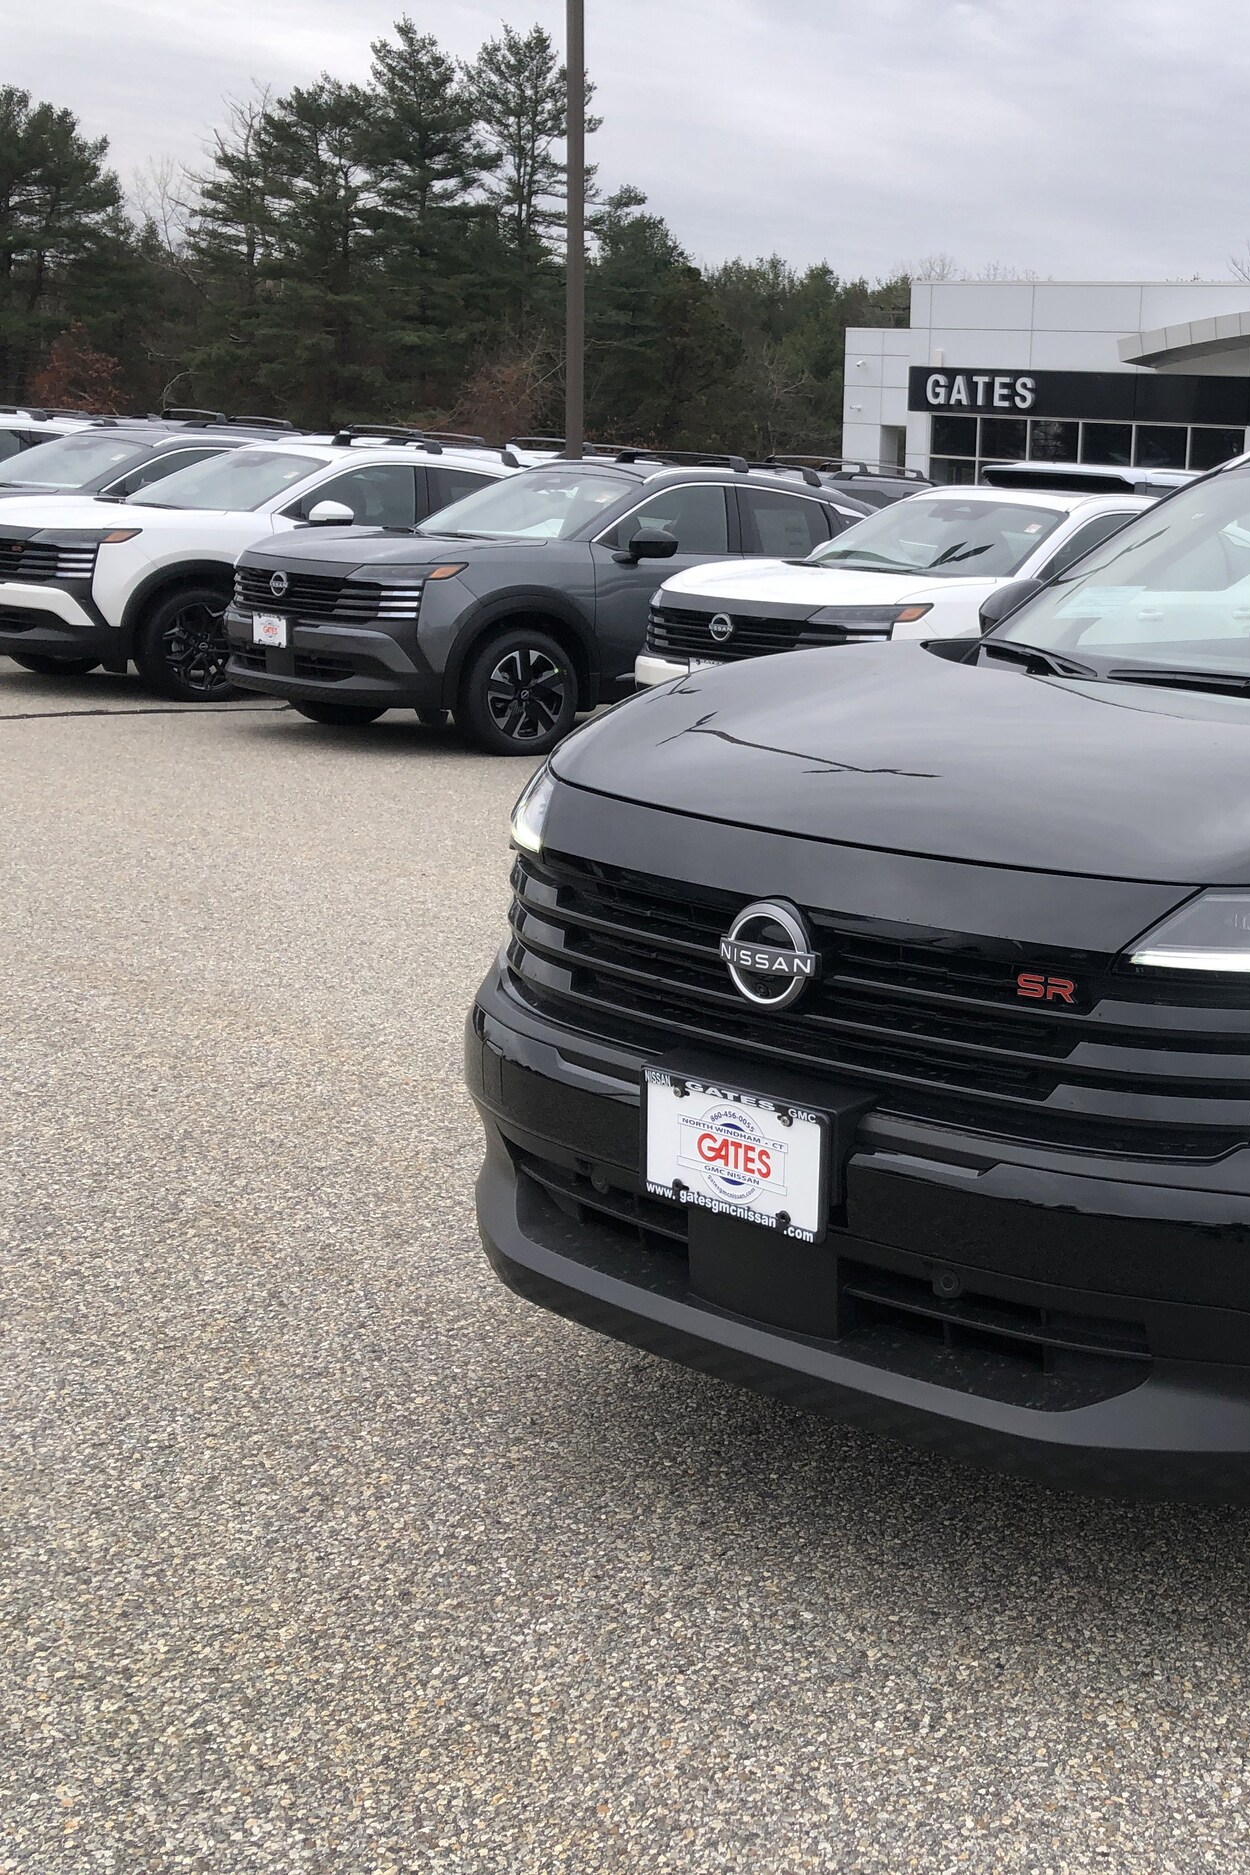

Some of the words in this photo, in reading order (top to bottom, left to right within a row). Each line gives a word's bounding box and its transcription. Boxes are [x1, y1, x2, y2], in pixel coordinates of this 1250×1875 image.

[926, 373, 1036, 409] GATES
[720, 942, 811, 974] NISSAN
[1017, 973, 1076, 1003] SR
[644, 1070, 671, 1087] NISSAN
[685, 1081, 776, 1111] GATES
[788, 1108, 817, 1124] GMC
[682, 1117, 713, 1131] NORTH
[714, 1125, 761, 1144] WINDHAM
[772, 1142, 784, 1150] CT
[710, 1110, 755, 1133] 860-456-0055
[697, 1133, 771, 1178] GATES
[704, 1165, 725, 1175] GMC
[727, 1171, 760, 1186] NISSAN
[646, 1182, 676, 1200] www.
[679, 1189, 777, 1229] gatesgmcnissan
[783, 1225, 814, 1243] .com
